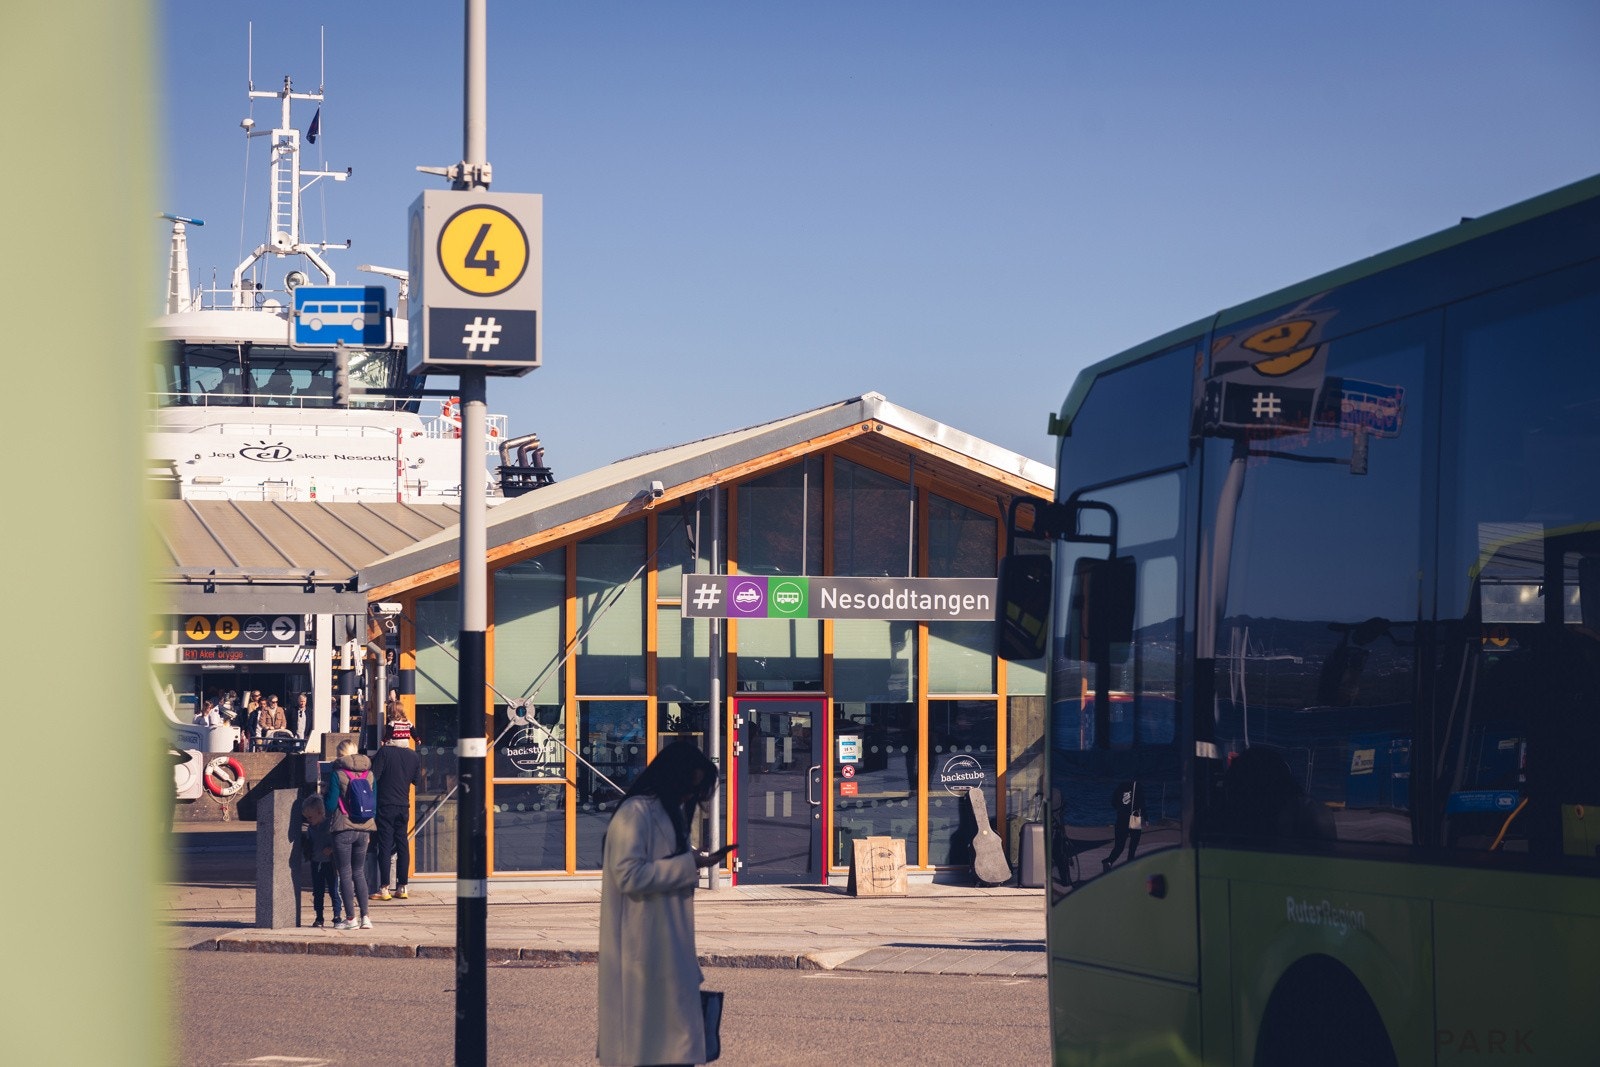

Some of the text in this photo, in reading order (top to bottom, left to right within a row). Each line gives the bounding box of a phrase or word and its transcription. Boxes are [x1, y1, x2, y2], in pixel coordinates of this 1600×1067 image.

[464, 223, 500, 277] 4
[820, 587, 990, 616] Nesoddtangen
[193, 621, 233, 635] A B
[940, 770, 985, 783] backstube
[1286, 896, 1366, 936] RuterRegion
